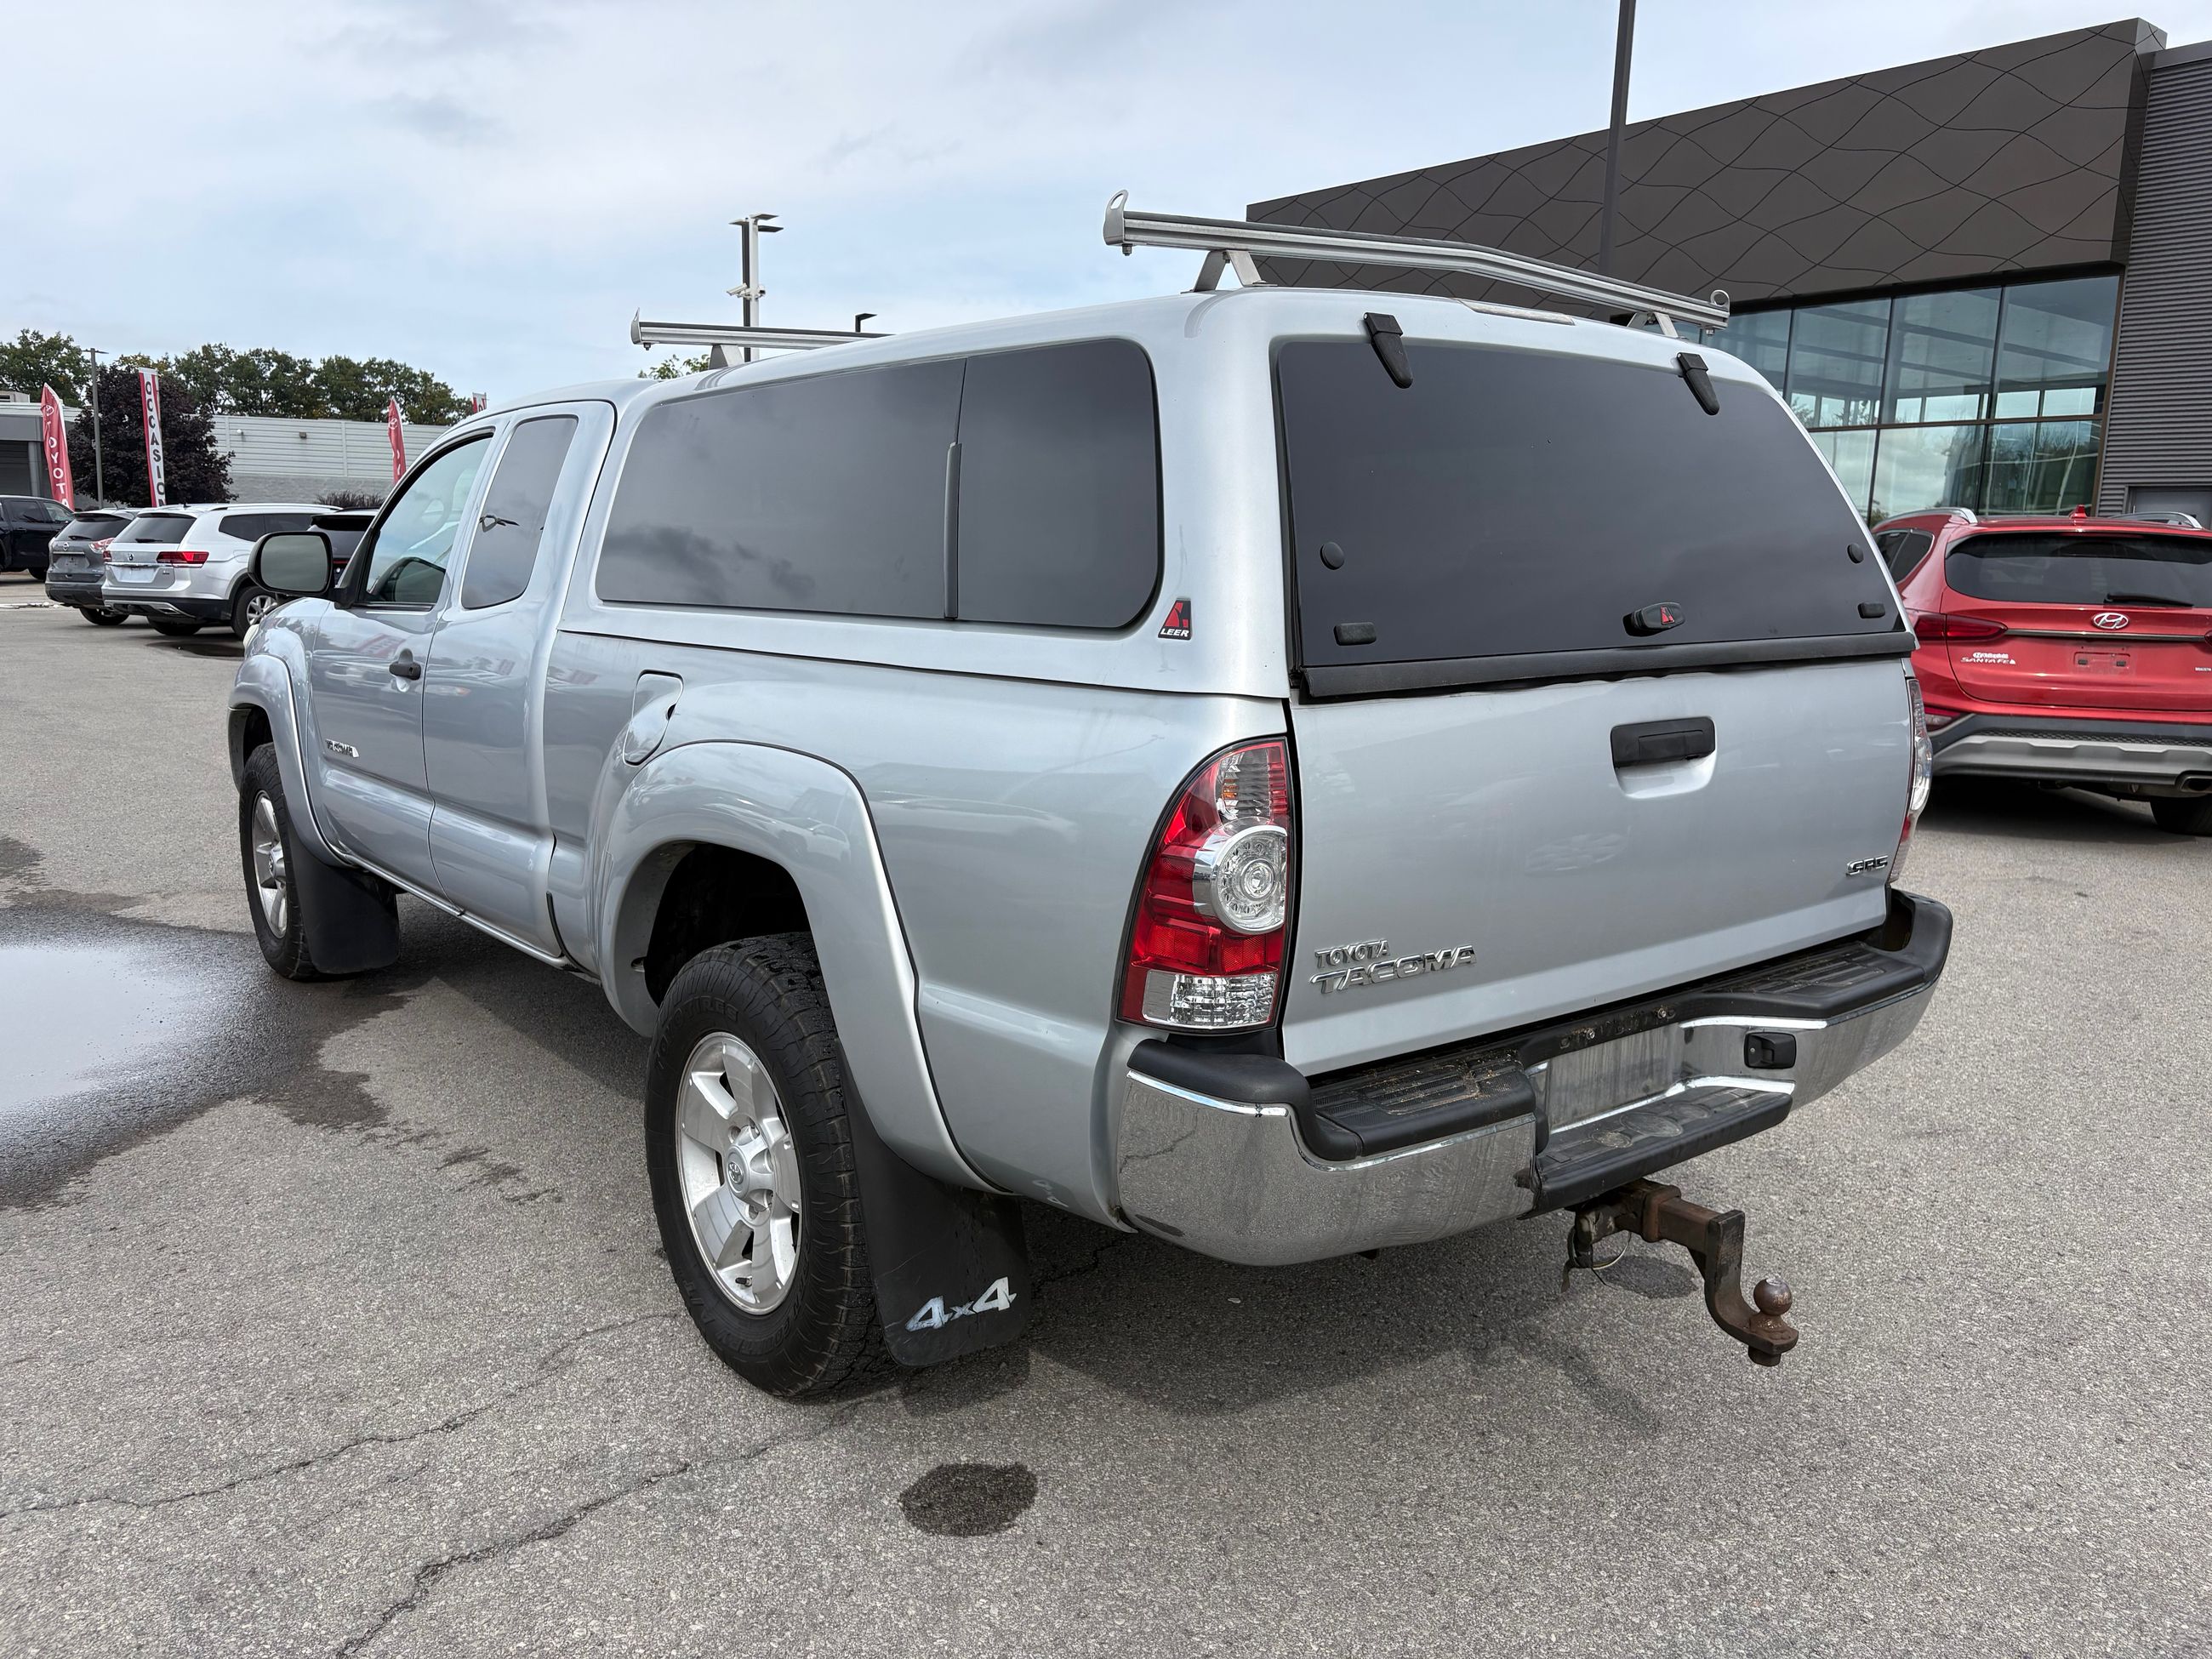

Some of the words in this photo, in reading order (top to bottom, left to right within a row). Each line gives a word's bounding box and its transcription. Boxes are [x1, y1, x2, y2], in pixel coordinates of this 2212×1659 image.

[1160, 628, 1189, 637] LEER
[1846, 855, 1889, 875] SR5
[1314, 939, 1390, 968] TOYOTA
[1309, 944, 1477, 994] TACOMA
[904, 1276, 1018, 1332] 4x4
